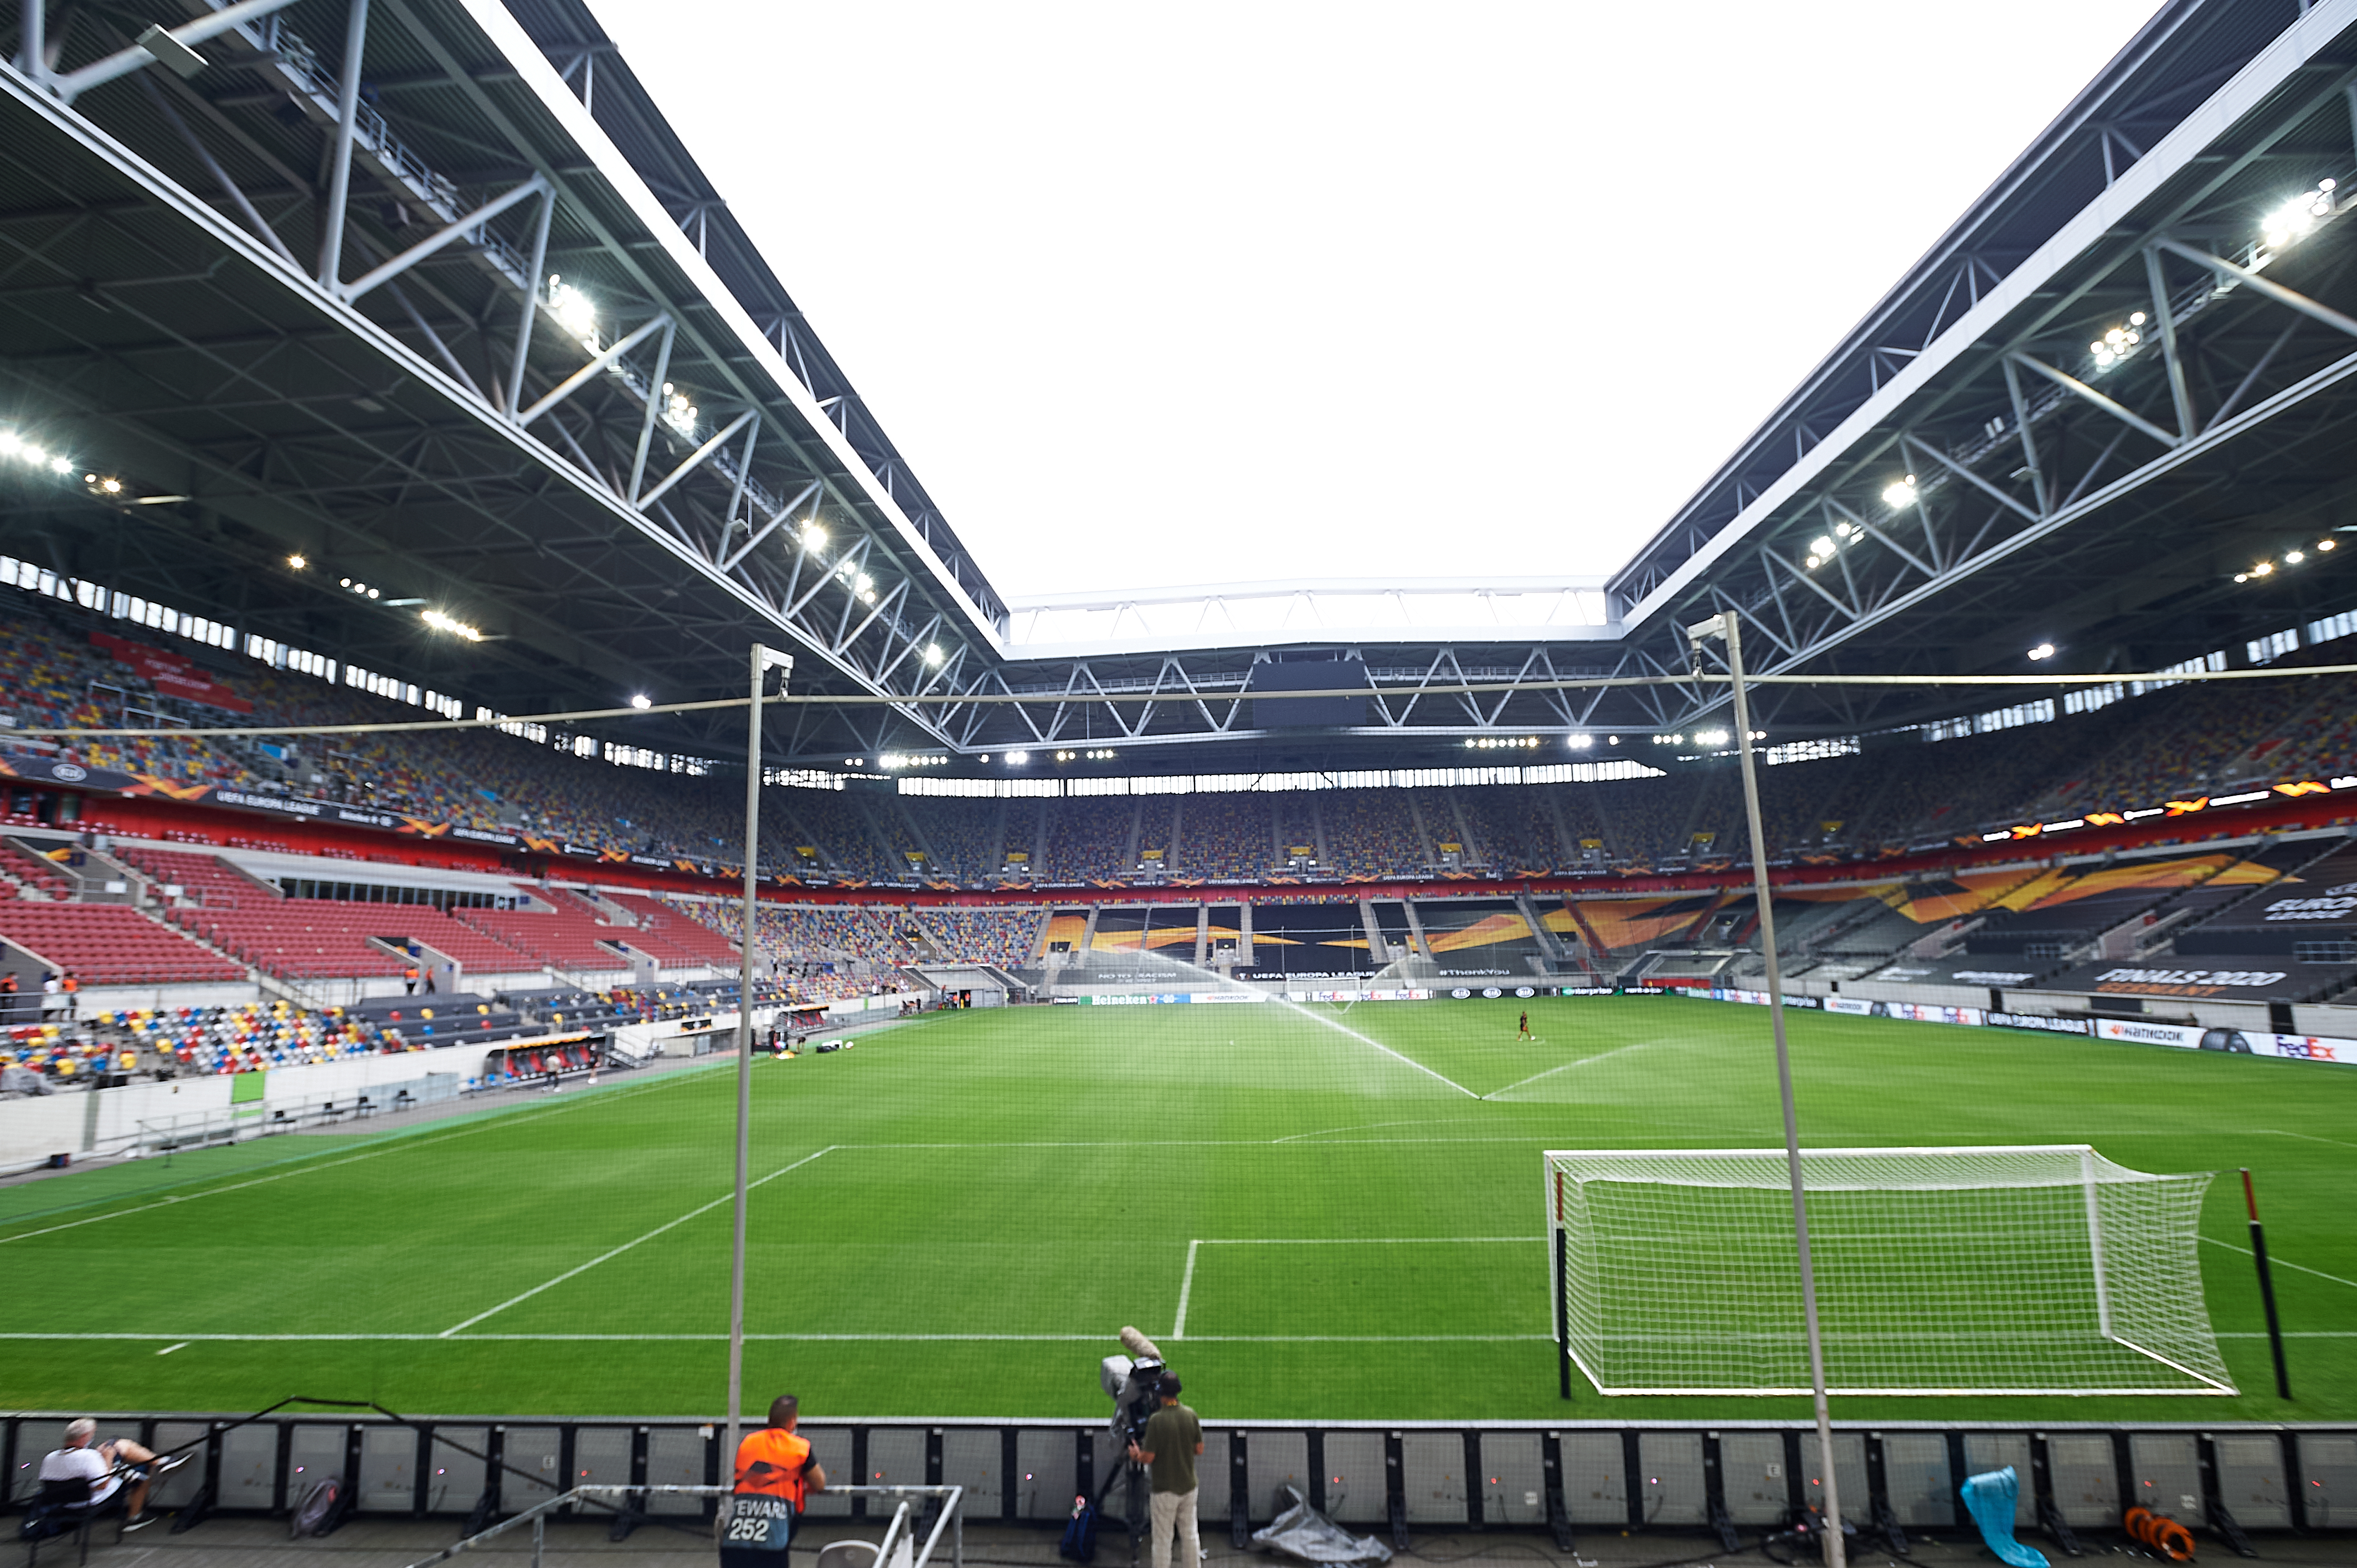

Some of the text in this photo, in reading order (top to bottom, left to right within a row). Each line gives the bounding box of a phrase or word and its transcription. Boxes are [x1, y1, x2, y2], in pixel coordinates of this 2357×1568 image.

[217, 790, 320, 816] UEFA EUROPA LEAGUE
[2094, 968, 2287, 986] FINALS 2020
[1092, 995, 1147, 1005] Heineken
[1319, 991, 1345, 1001] FedEx
[1361, 990, 1382, 1000] edEx
[1396, 989, 1421, 999] FedEx
[1988, 1012, 2087, 1034] UEFA EUROPA LEAGUE
[2276, 1035, 2336, 1060] FedEx
[729, 1517, 770, 1541] 252
